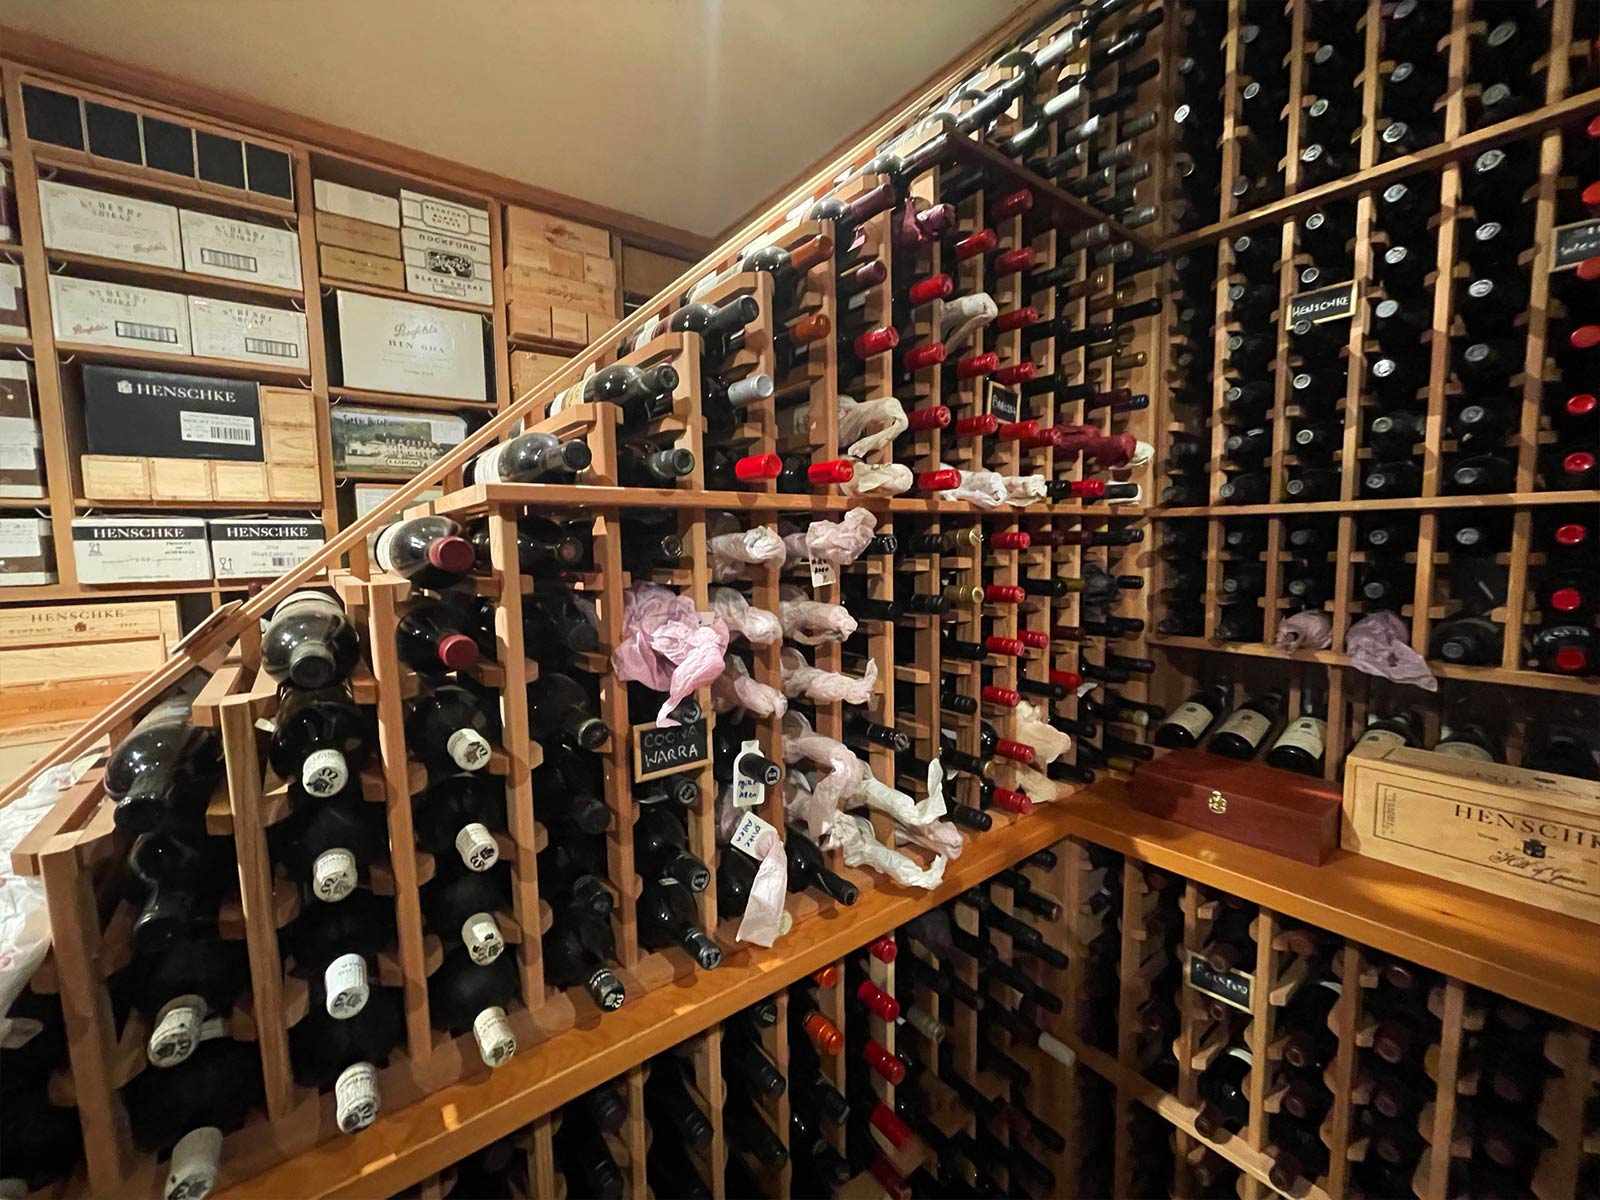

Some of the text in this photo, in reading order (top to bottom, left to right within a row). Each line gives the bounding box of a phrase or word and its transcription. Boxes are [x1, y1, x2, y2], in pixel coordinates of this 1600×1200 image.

[419, 234, 477, 252] ROCKFORD
[1292, 296, 1349, 318] HENSCHKE
[136, 382, 237, 404] HENSCHKE
[93, 527, 185, 540] HENSCHKE
[226, 526, 309, 539] HENSCHKE
[31, 609, 125, 623] HENSCHKE
[645, 743, 698, 768] WARRA
